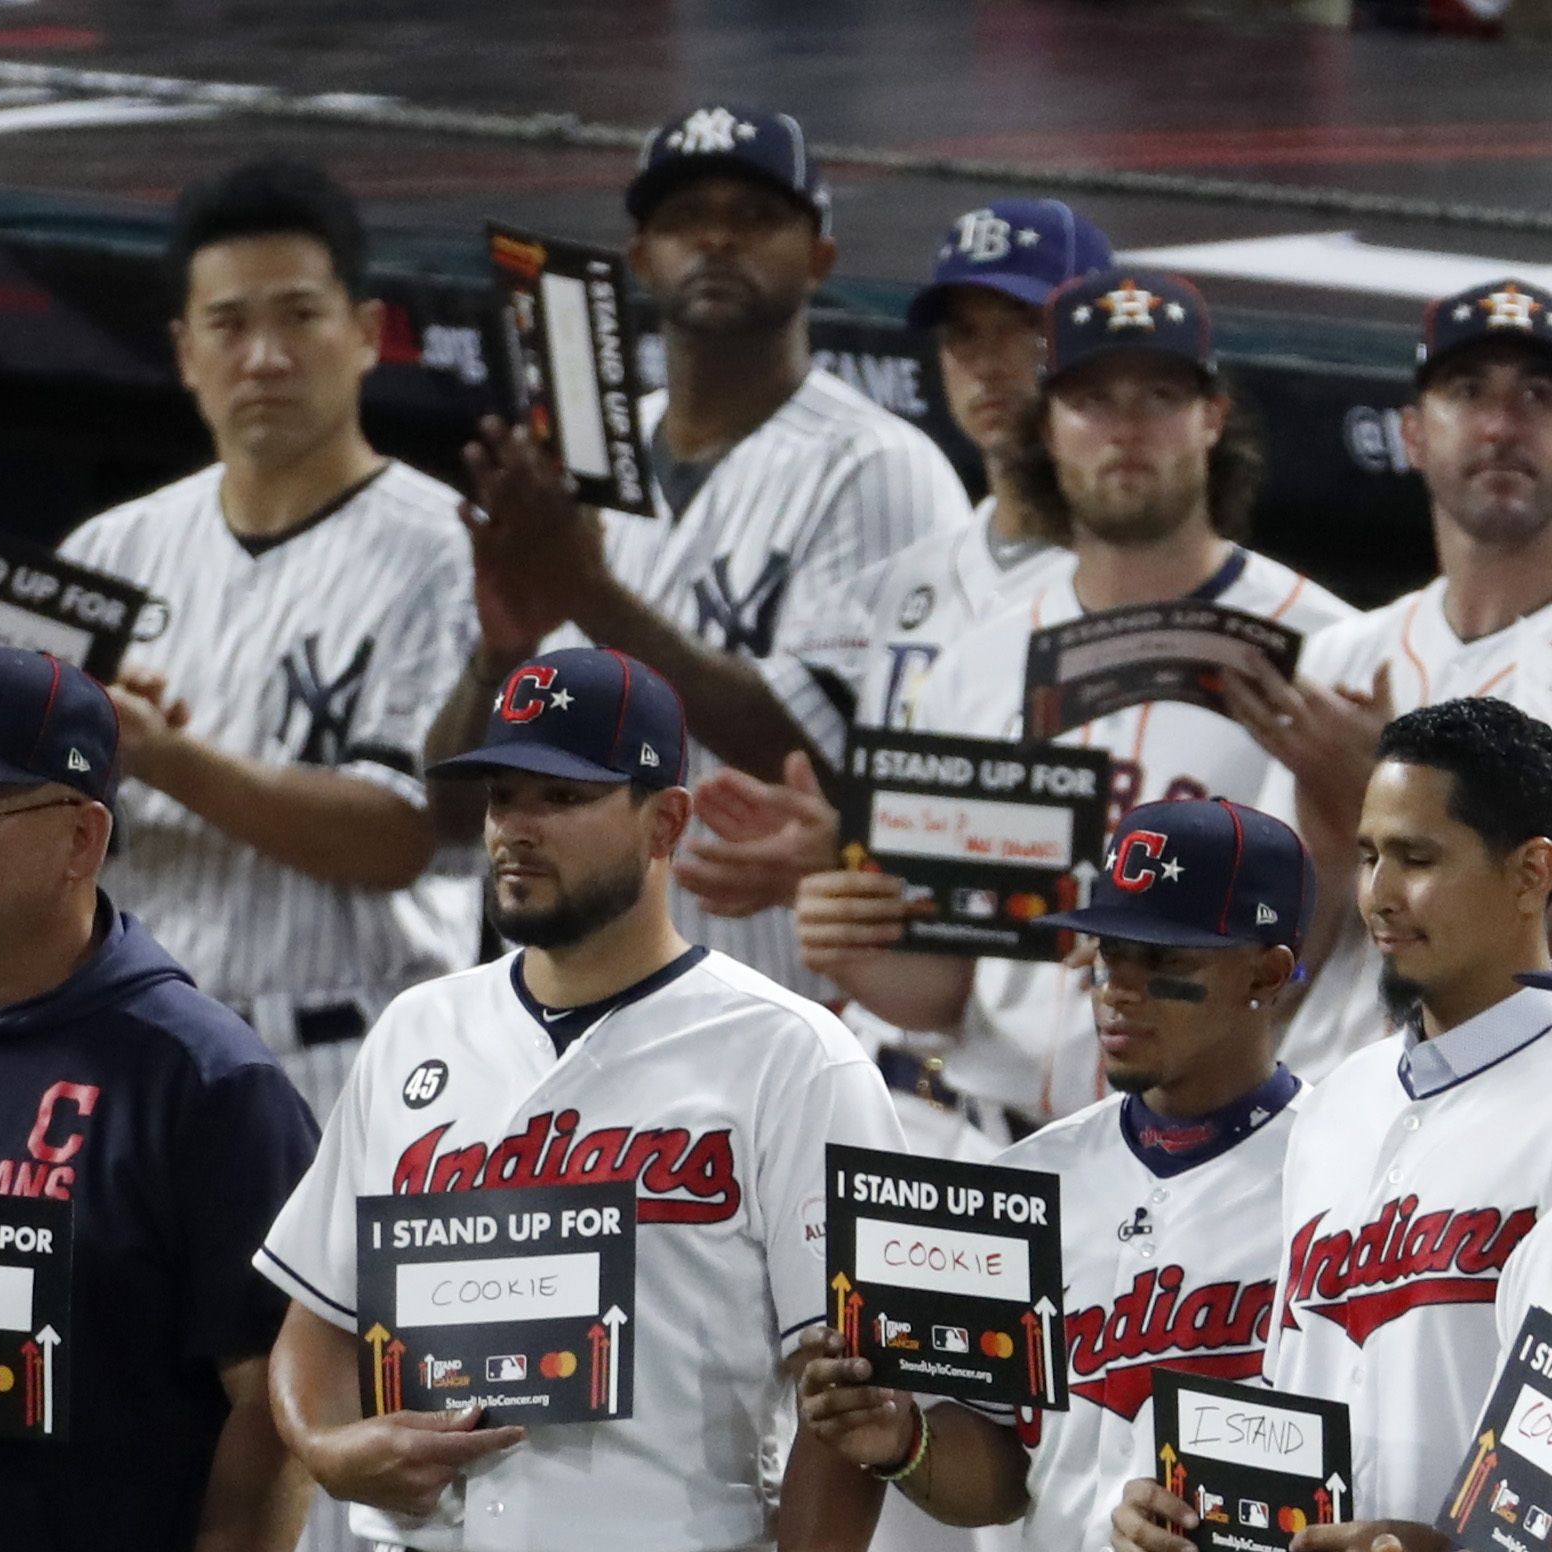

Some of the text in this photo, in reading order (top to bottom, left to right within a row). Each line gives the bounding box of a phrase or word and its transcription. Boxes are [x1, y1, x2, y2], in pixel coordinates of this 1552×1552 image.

[10, 564, 61, 601] UP
[60, 583, 129, 631] FOR
[500, 665, 559, 724] C
[853, 746, 868, 778] I
[871, 749, 976, 788] STAND
[978, 759, 1027, 792] UP
[1029, 763, 1097, 798] FOR
[1110, 829, 1168, 894] C
[404, 1066, 444, 1101] 45
[27, 1079, 101, 1164] C
[392, 1108, 741, 1224] Indians
[837, 1170, 1049, 1227] I STAND UP FOR
[372, 1206, 622, 1249] I STAND UP FOR
[883, 1240, 1003, 1276] COOKIE
[431, 1275, 560, 1306] COOKIE
[1518, 1333, 1535, 1363] I
[1188, 1405, 1304, 1456] I STAND
